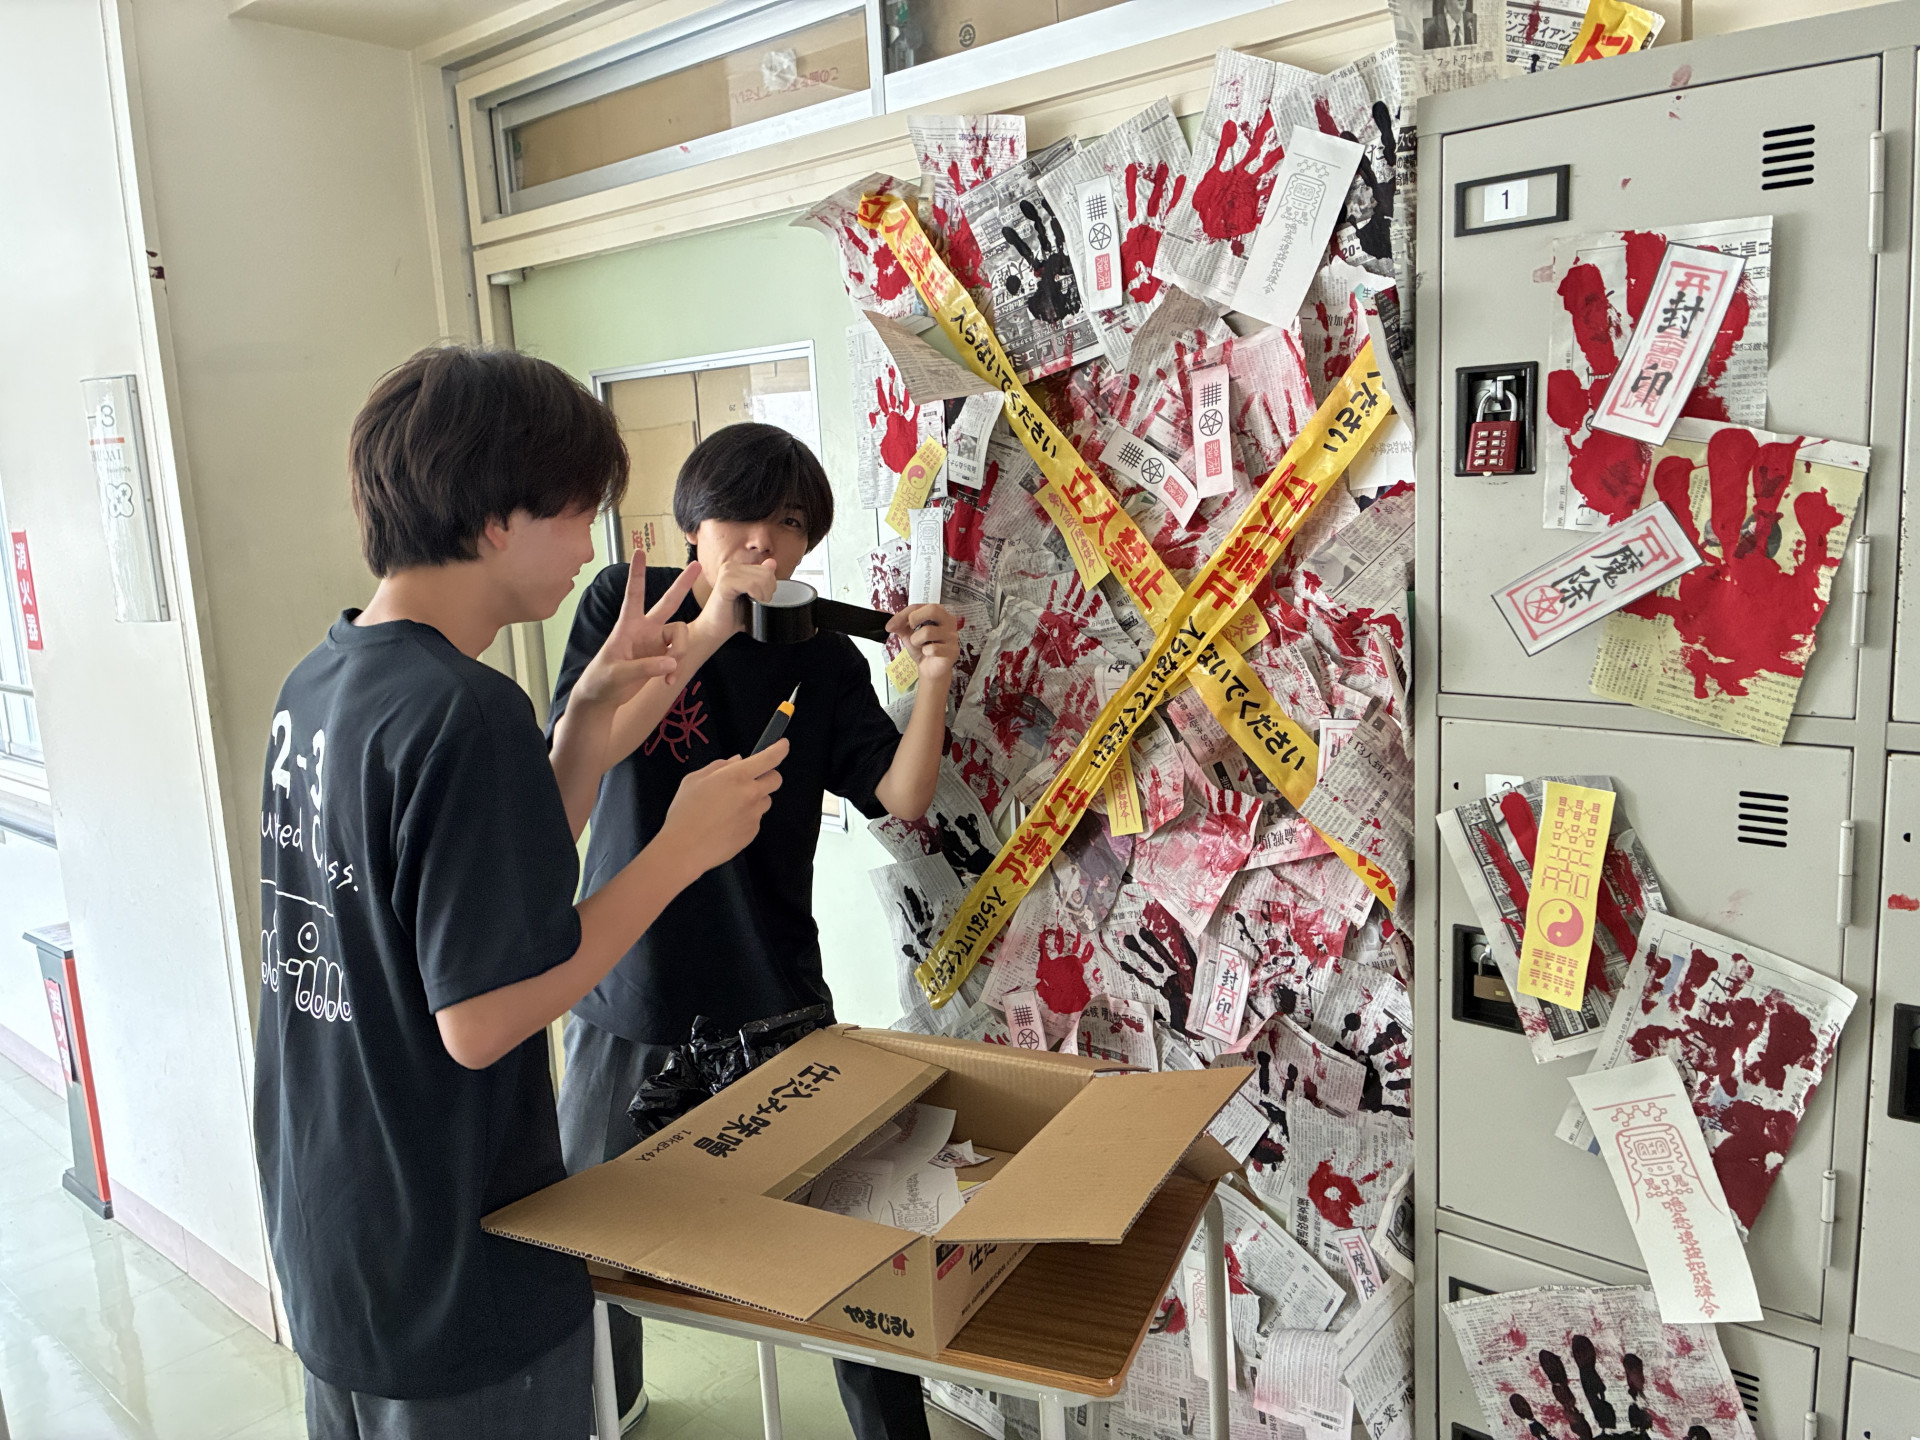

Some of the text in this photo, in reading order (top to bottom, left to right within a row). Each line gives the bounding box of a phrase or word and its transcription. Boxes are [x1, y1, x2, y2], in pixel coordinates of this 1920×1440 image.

[1501, 189, 1510, 210] 1
[950, 307, 1057, 459] 入らないでください
[1631, 290, 1704, 404] 封印
[1061, 467, 1164, 612] 立入禁止
[1194, 462, 1318, 611] 立入禁止
[15, 542, 39, 641] 消火器
[271, 709, 326, 812] 2-3
[996, 778, 1089, 886] 立入禁止
[694, 1062, 841, 1158] 仕込み味噌
[843, 1304, 915, 1339] やまじるし
